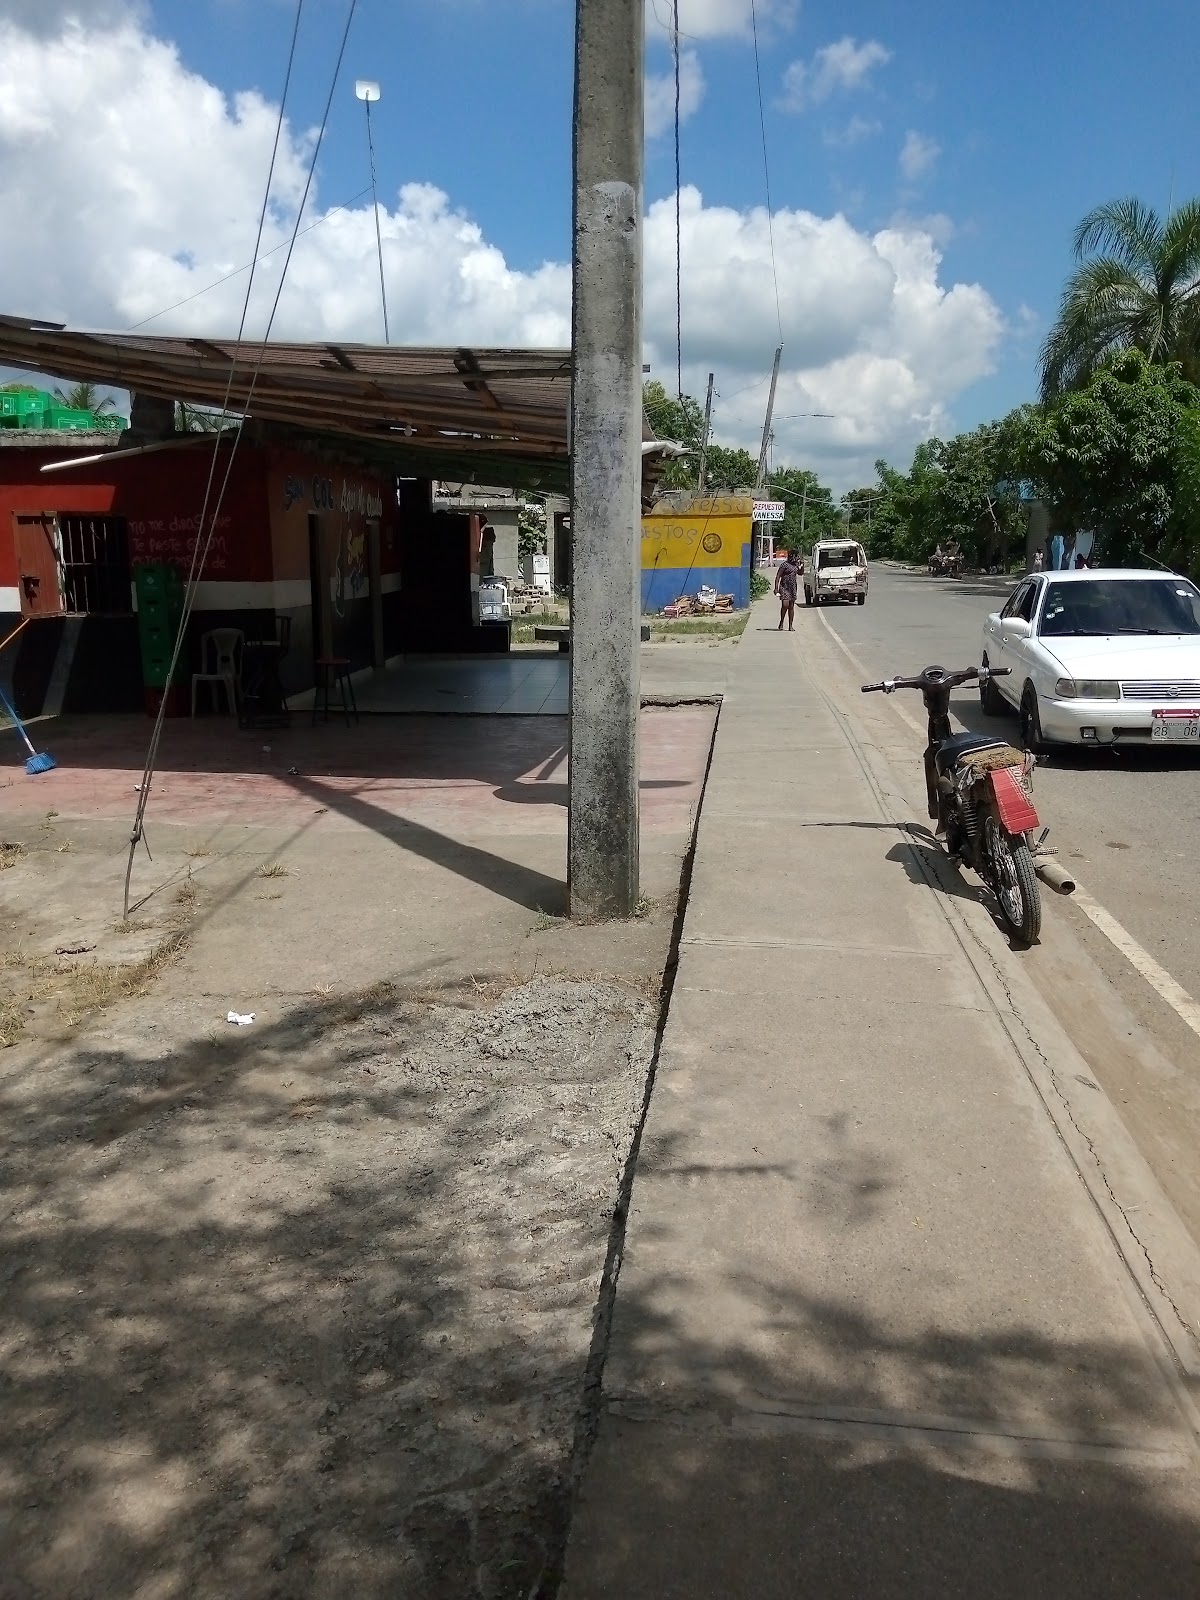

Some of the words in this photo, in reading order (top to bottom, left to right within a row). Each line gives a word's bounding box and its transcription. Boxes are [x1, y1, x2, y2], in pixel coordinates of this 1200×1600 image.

[754, 503, 785, 511] REPUESTOS
[753, 511, 784, 519] VANESSA
[1154, 726, 1167, 736] 28
[1184, 726, 1198, 736] 08
